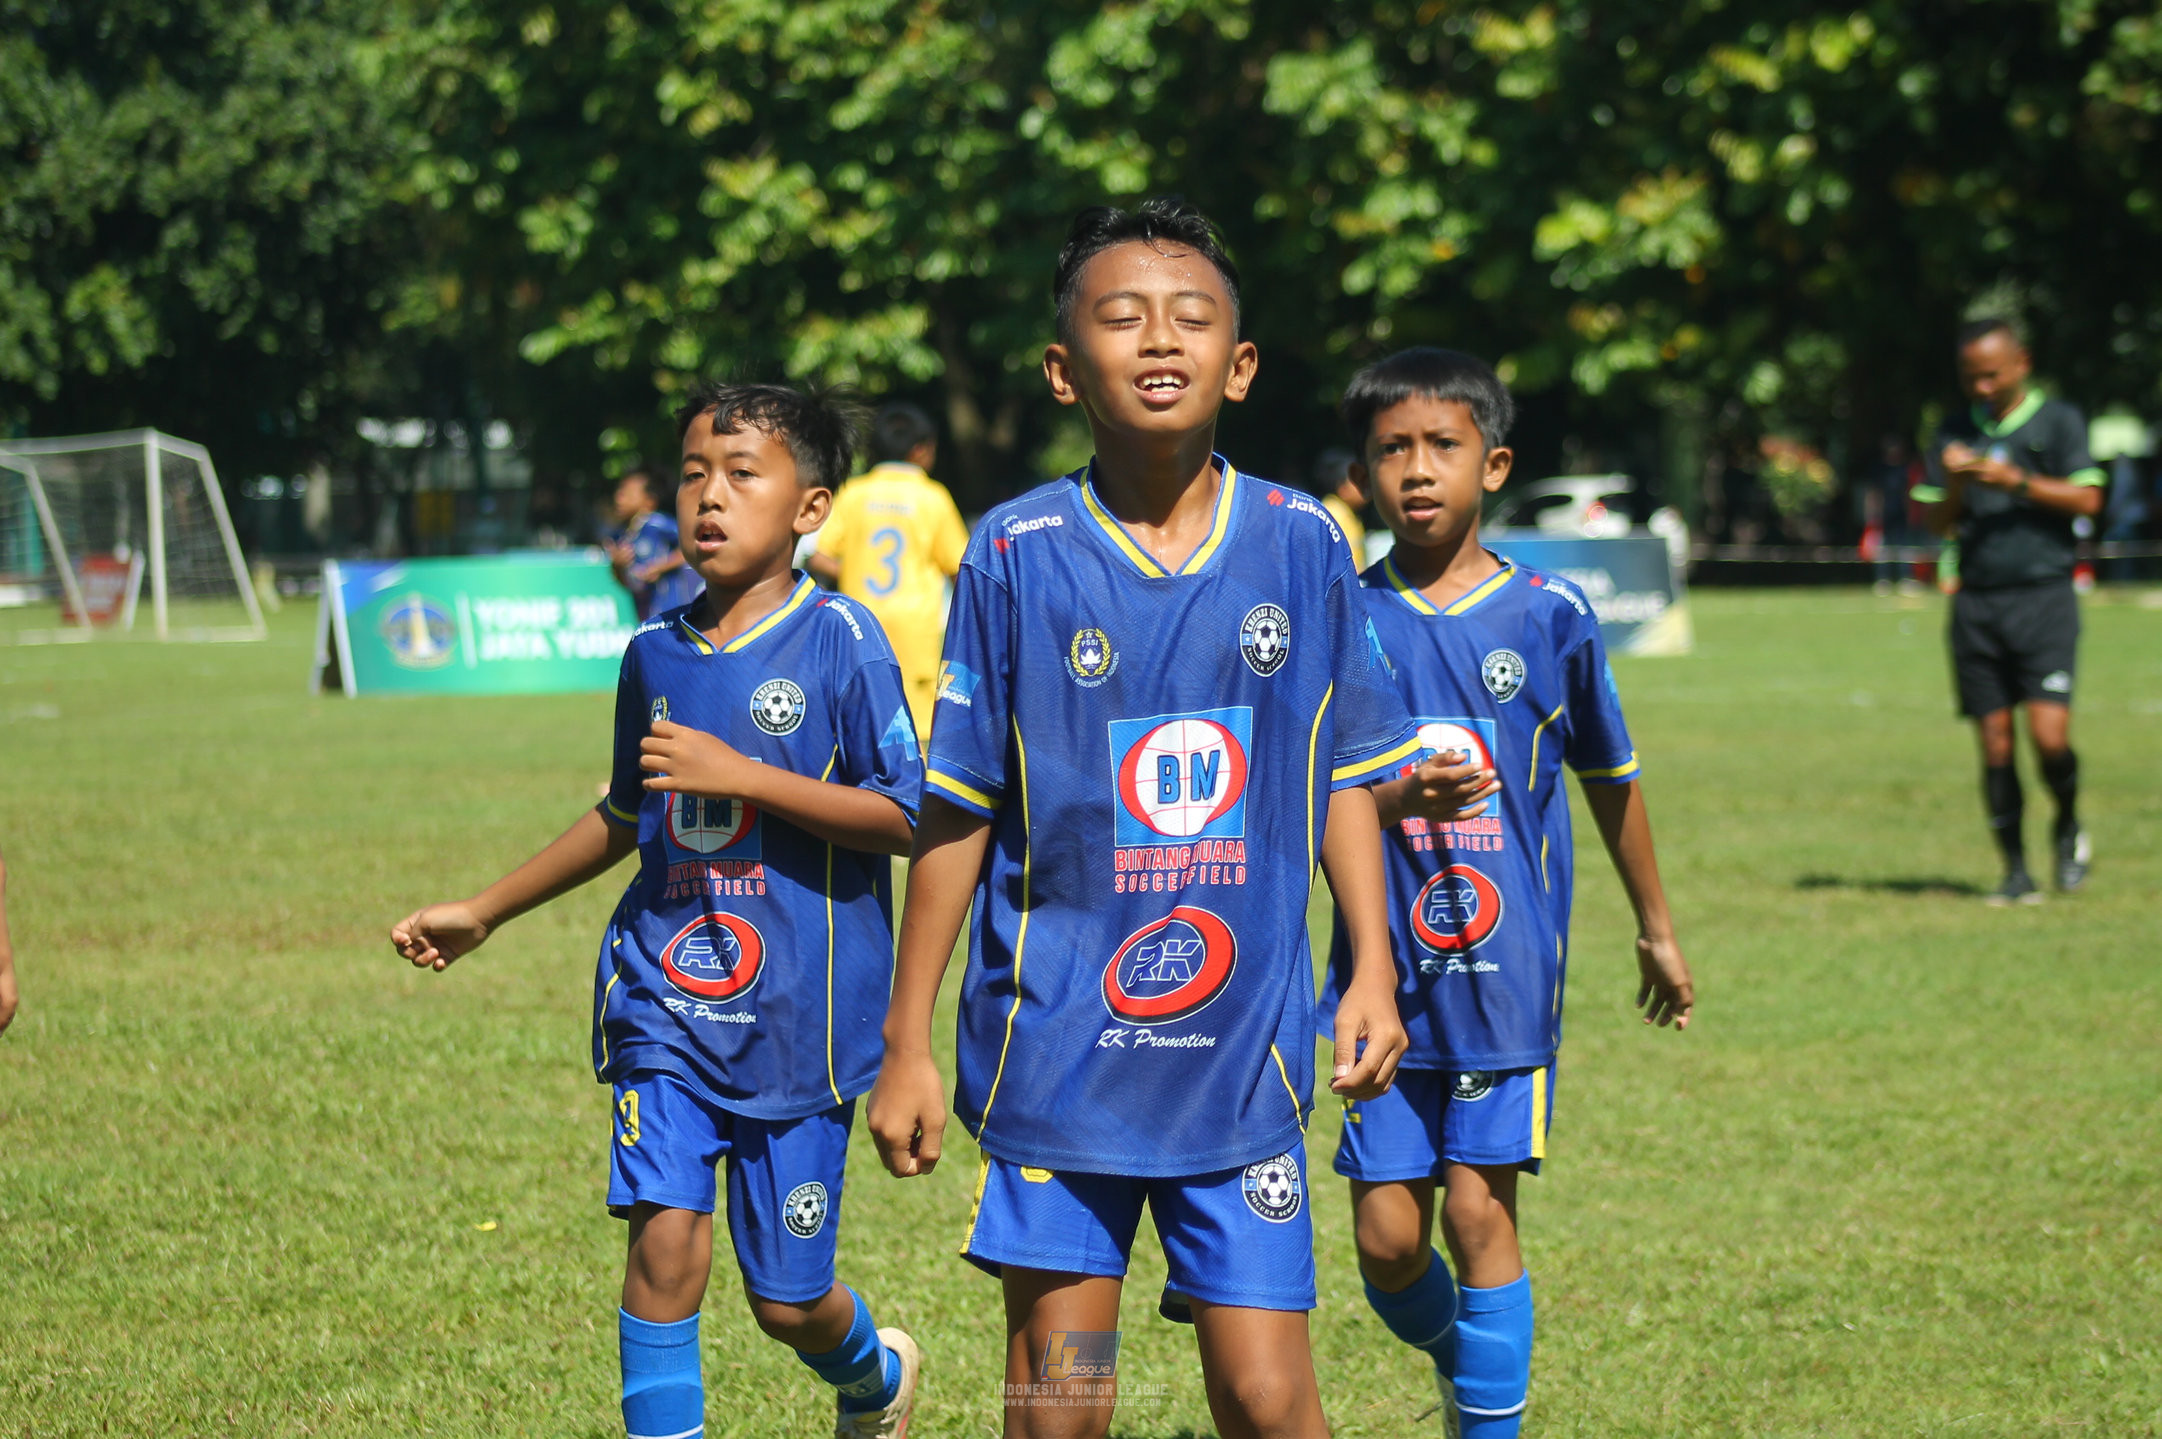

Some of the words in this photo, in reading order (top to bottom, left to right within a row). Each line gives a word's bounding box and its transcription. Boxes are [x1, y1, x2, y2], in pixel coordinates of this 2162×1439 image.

[865, 527, 905, 597] 3
[1269, 607, 1289, 635] UNITED
[1081, 638, 1099, 647] PSSI
[1115, 846, 1191, 872] BINTANG
[1186, 865, 1246, 885] FIELD
[714, 879, 767, 896] FIELD
[662, 997, 692, 1016] RK
[693, 1004, 757, 1024] Promotion
[1095, 1028, 1131, 1049] RK
[1133, 1028, 1217, 1049] Promotion
